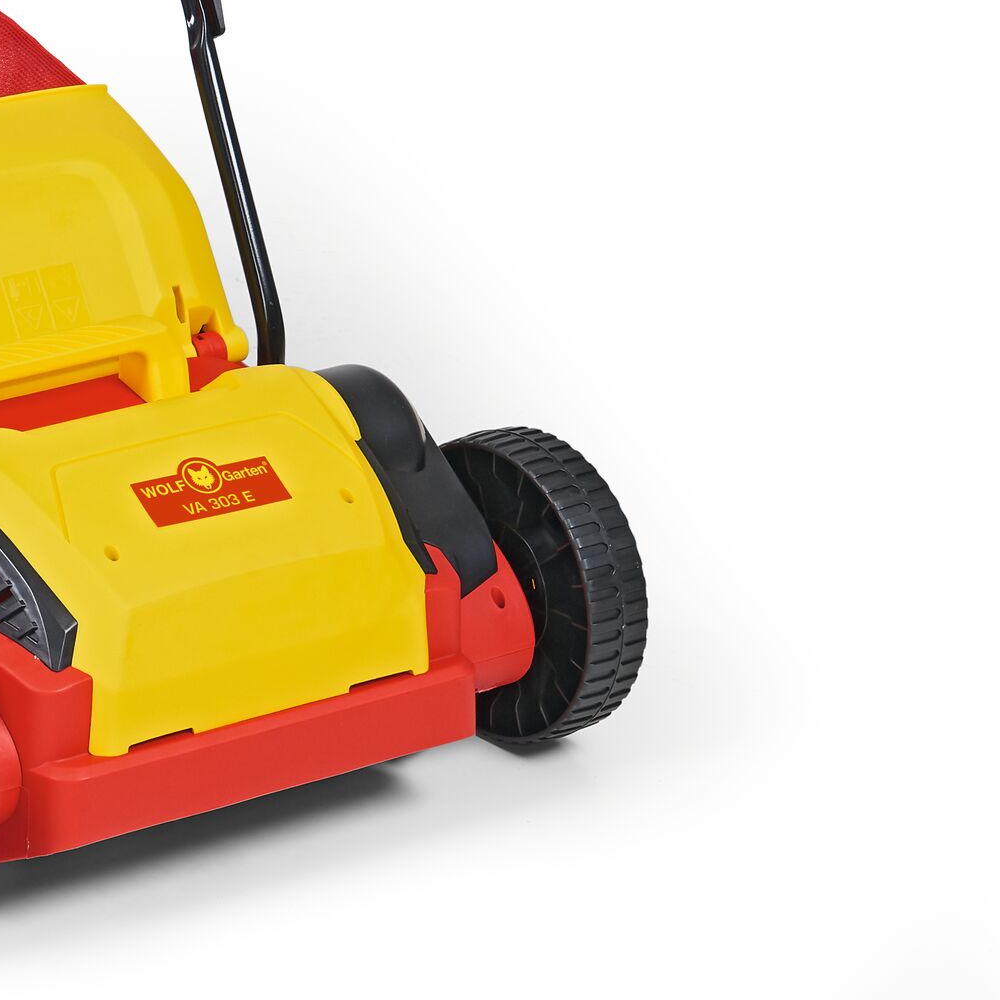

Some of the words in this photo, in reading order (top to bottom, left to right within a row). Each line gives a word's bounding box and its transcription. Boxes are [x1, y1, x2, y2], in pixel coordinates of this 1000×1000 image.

[140, 480, 186, 499] WOLF
[182, 503, 207, 515] VA
[208, 494, 240, 510] 303
[241, 490, 256, 502] E
